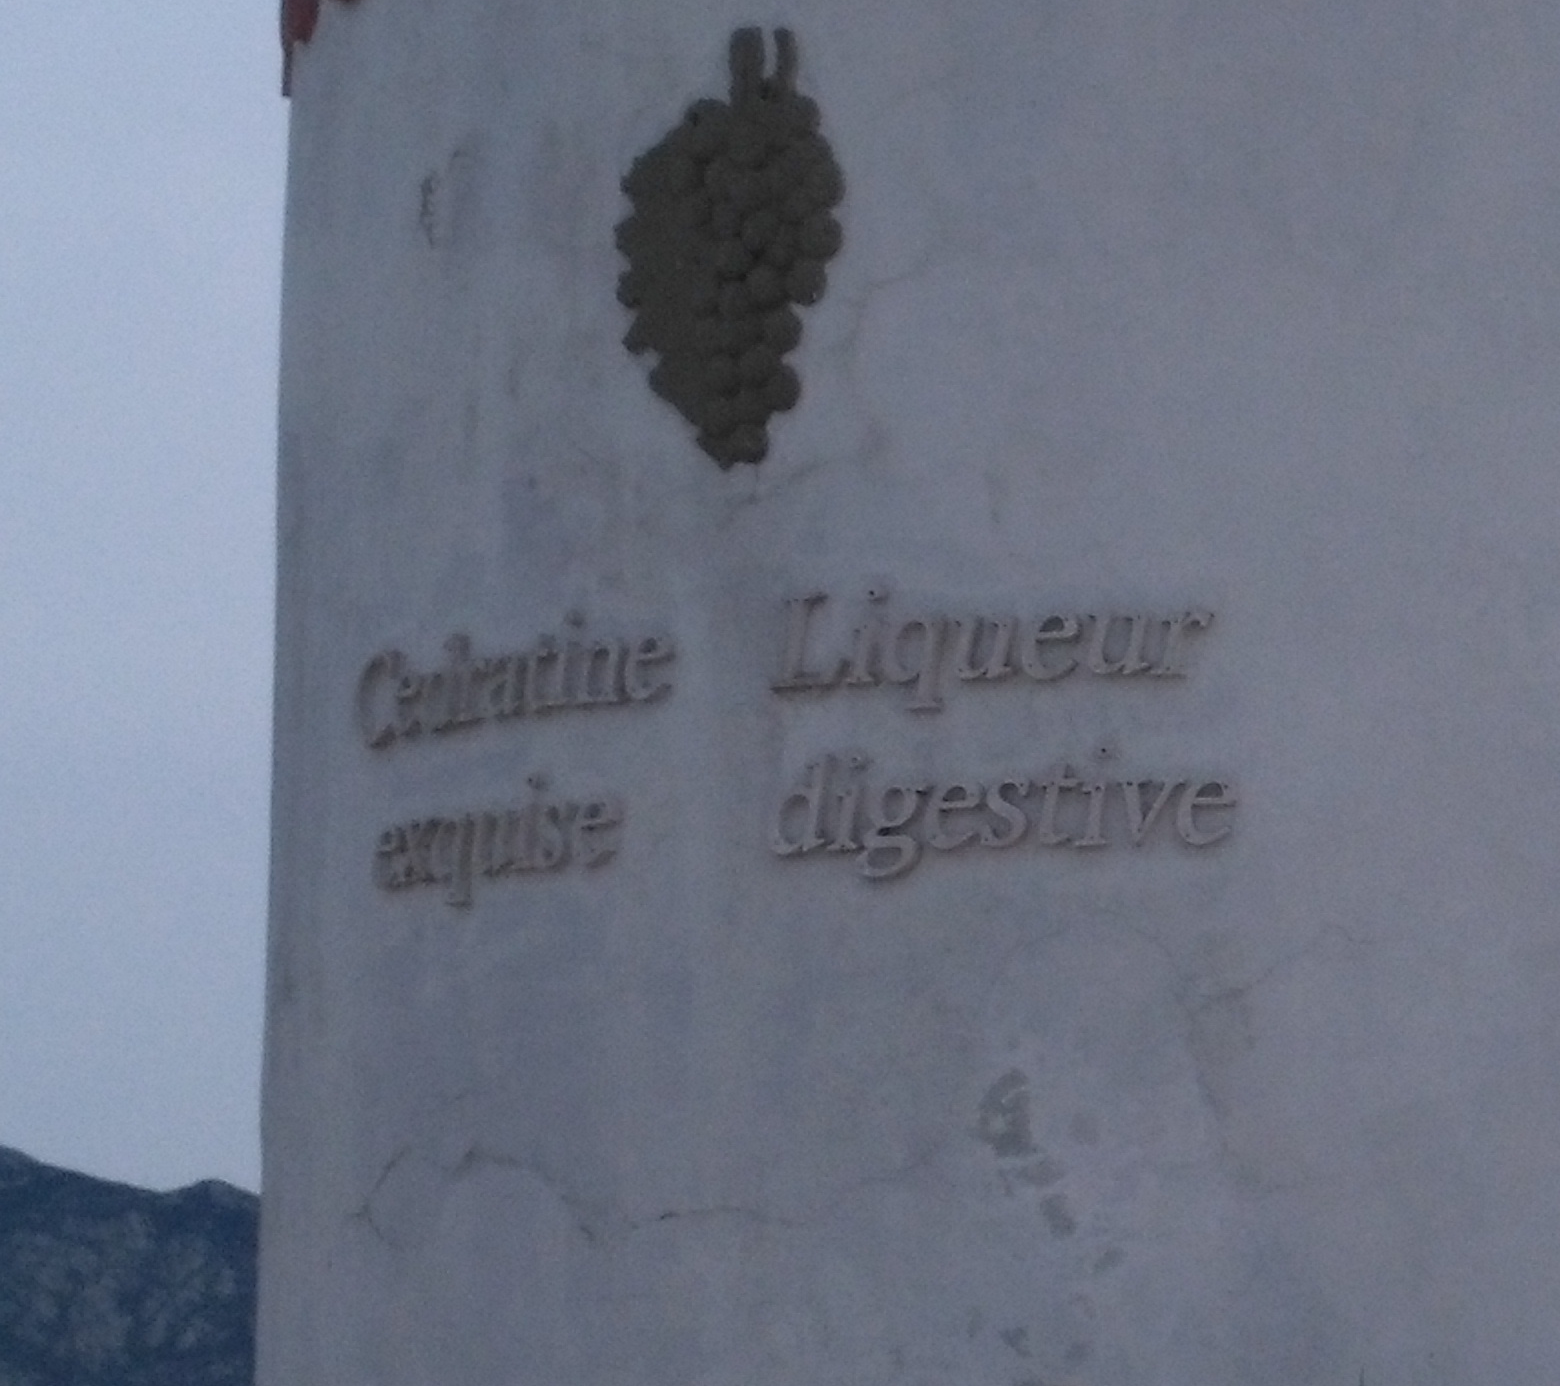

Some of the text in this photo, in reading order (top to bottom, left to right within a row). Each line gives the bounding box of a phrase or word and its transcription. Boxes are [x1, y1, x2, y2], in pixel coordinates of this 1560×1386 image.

[770, 583, 1216, 715] Liqueur
[374, 769, 627, 910] exquise
[772, 749, 1236, 881] digestive
